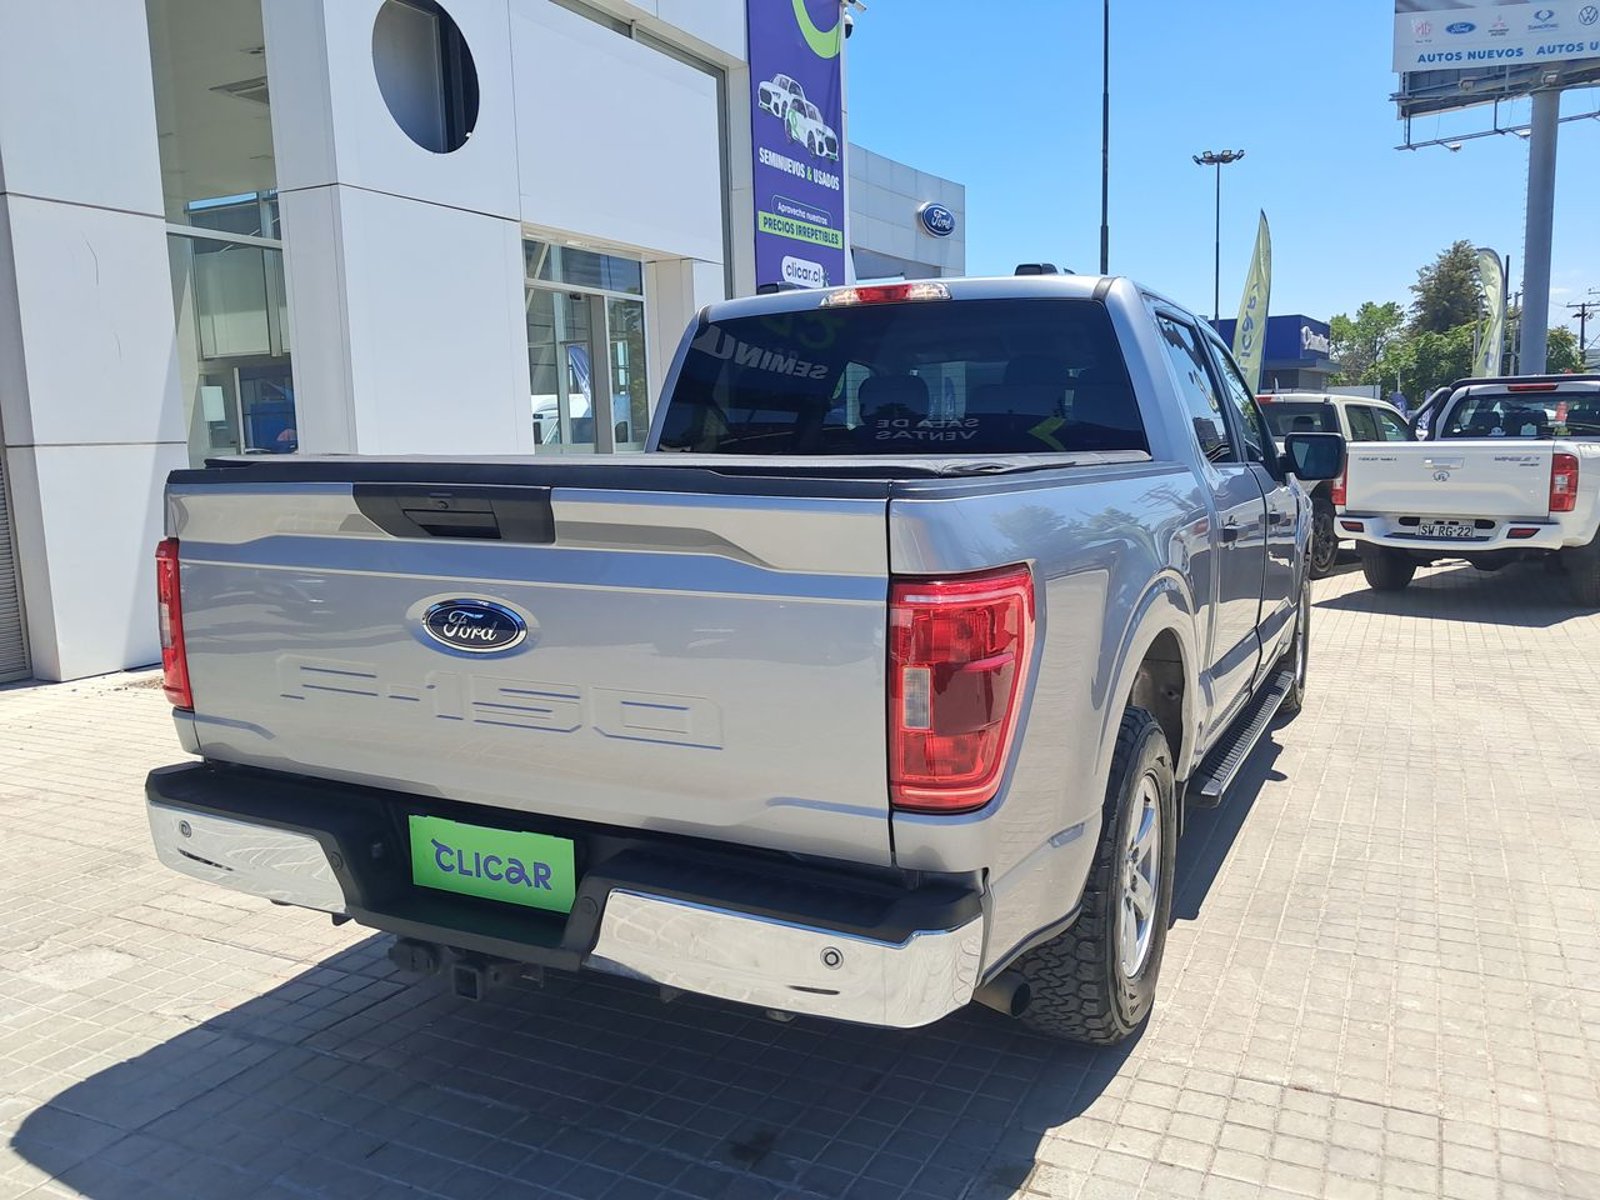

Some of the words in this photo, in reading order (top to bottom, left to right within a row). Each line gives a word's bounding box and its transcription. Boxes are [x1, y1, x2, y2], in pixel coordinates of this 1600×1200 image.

[1417, 51, 1462, 63] AUTOS
[1467, 47, 1524, 60] NUEVOS
[1536, 42, 1585, 55] AUTOS
[759, 147, 805, 179] SEMINUEVOS
[806, 166, 813, 181] &
[813, 168, 840, 190] USADOS
[777, 201, 806, 219] Aprovecha
[806, 211, 828, 226] nuestros
[931, 209, 952, 230] Ford
[763, 215, 795, 235] PRECIOS
[795, 224, 839, 245] IRREPETIBLES
[785, 262, 821, 282] clicar.cl
[443, 610, 498, 641] Ford
[277, 654, 724, 751] F-150
